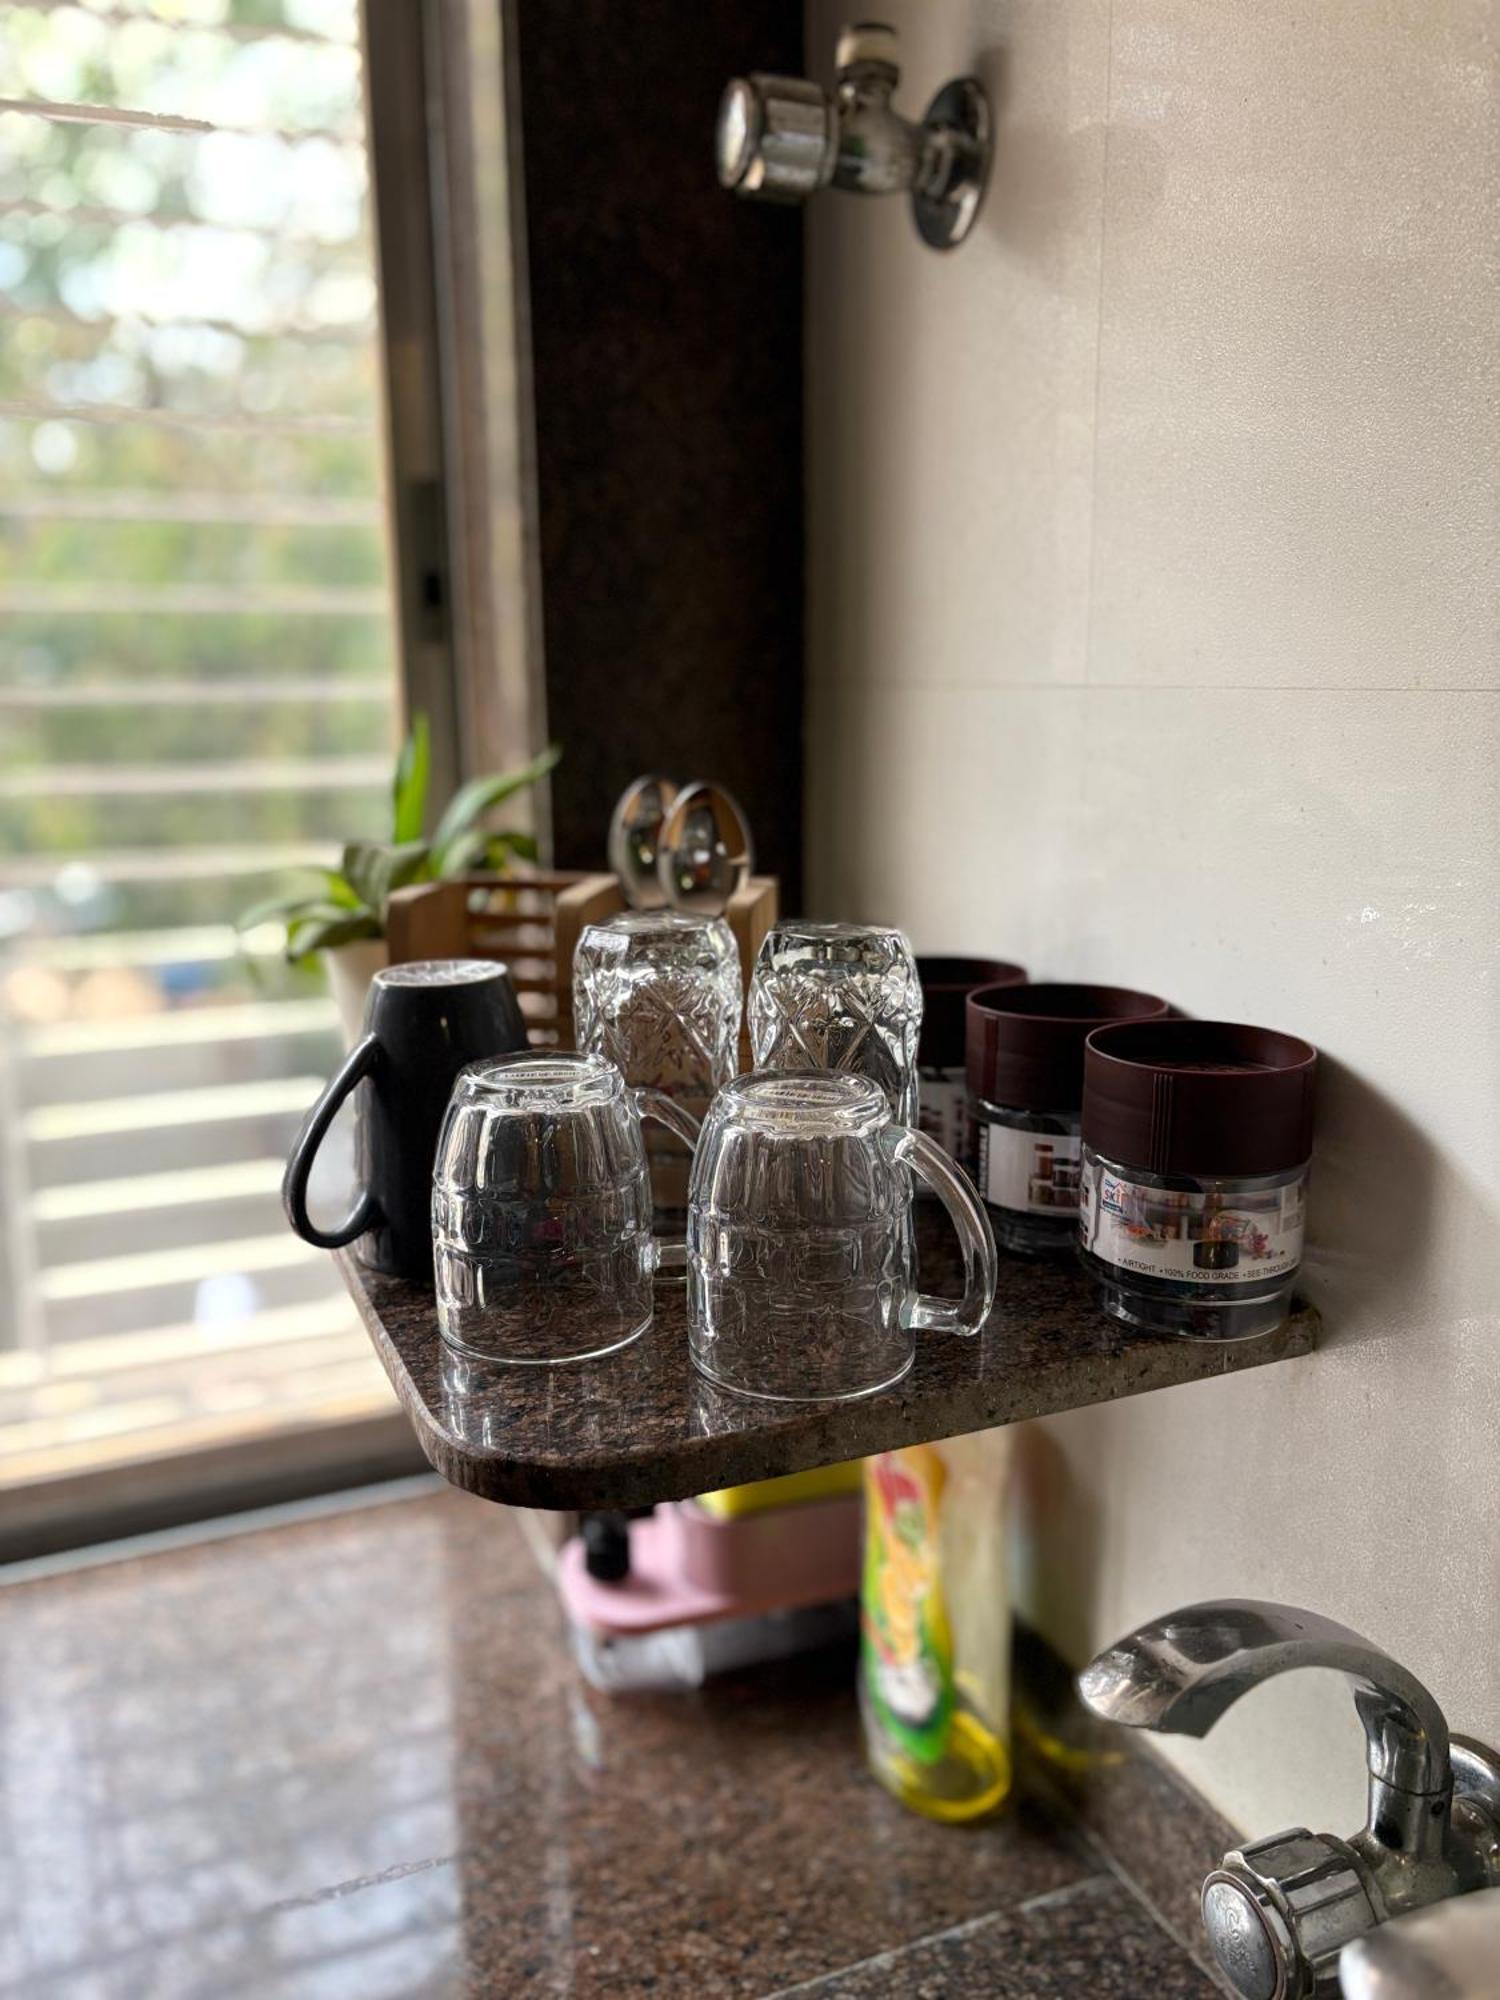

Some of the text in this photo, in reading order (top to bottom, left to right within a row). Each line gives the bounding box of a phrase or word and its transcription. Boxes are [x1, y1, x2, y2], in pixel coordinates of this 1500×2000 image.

[1122, 1258, 1156, 1273] AIRTIGHT
[1164, 1267, 1185, 1279] 100%
[1186, 1270, 1210, 1280] FOOD
[1211, 1271, 1240, 1280] GRADE
